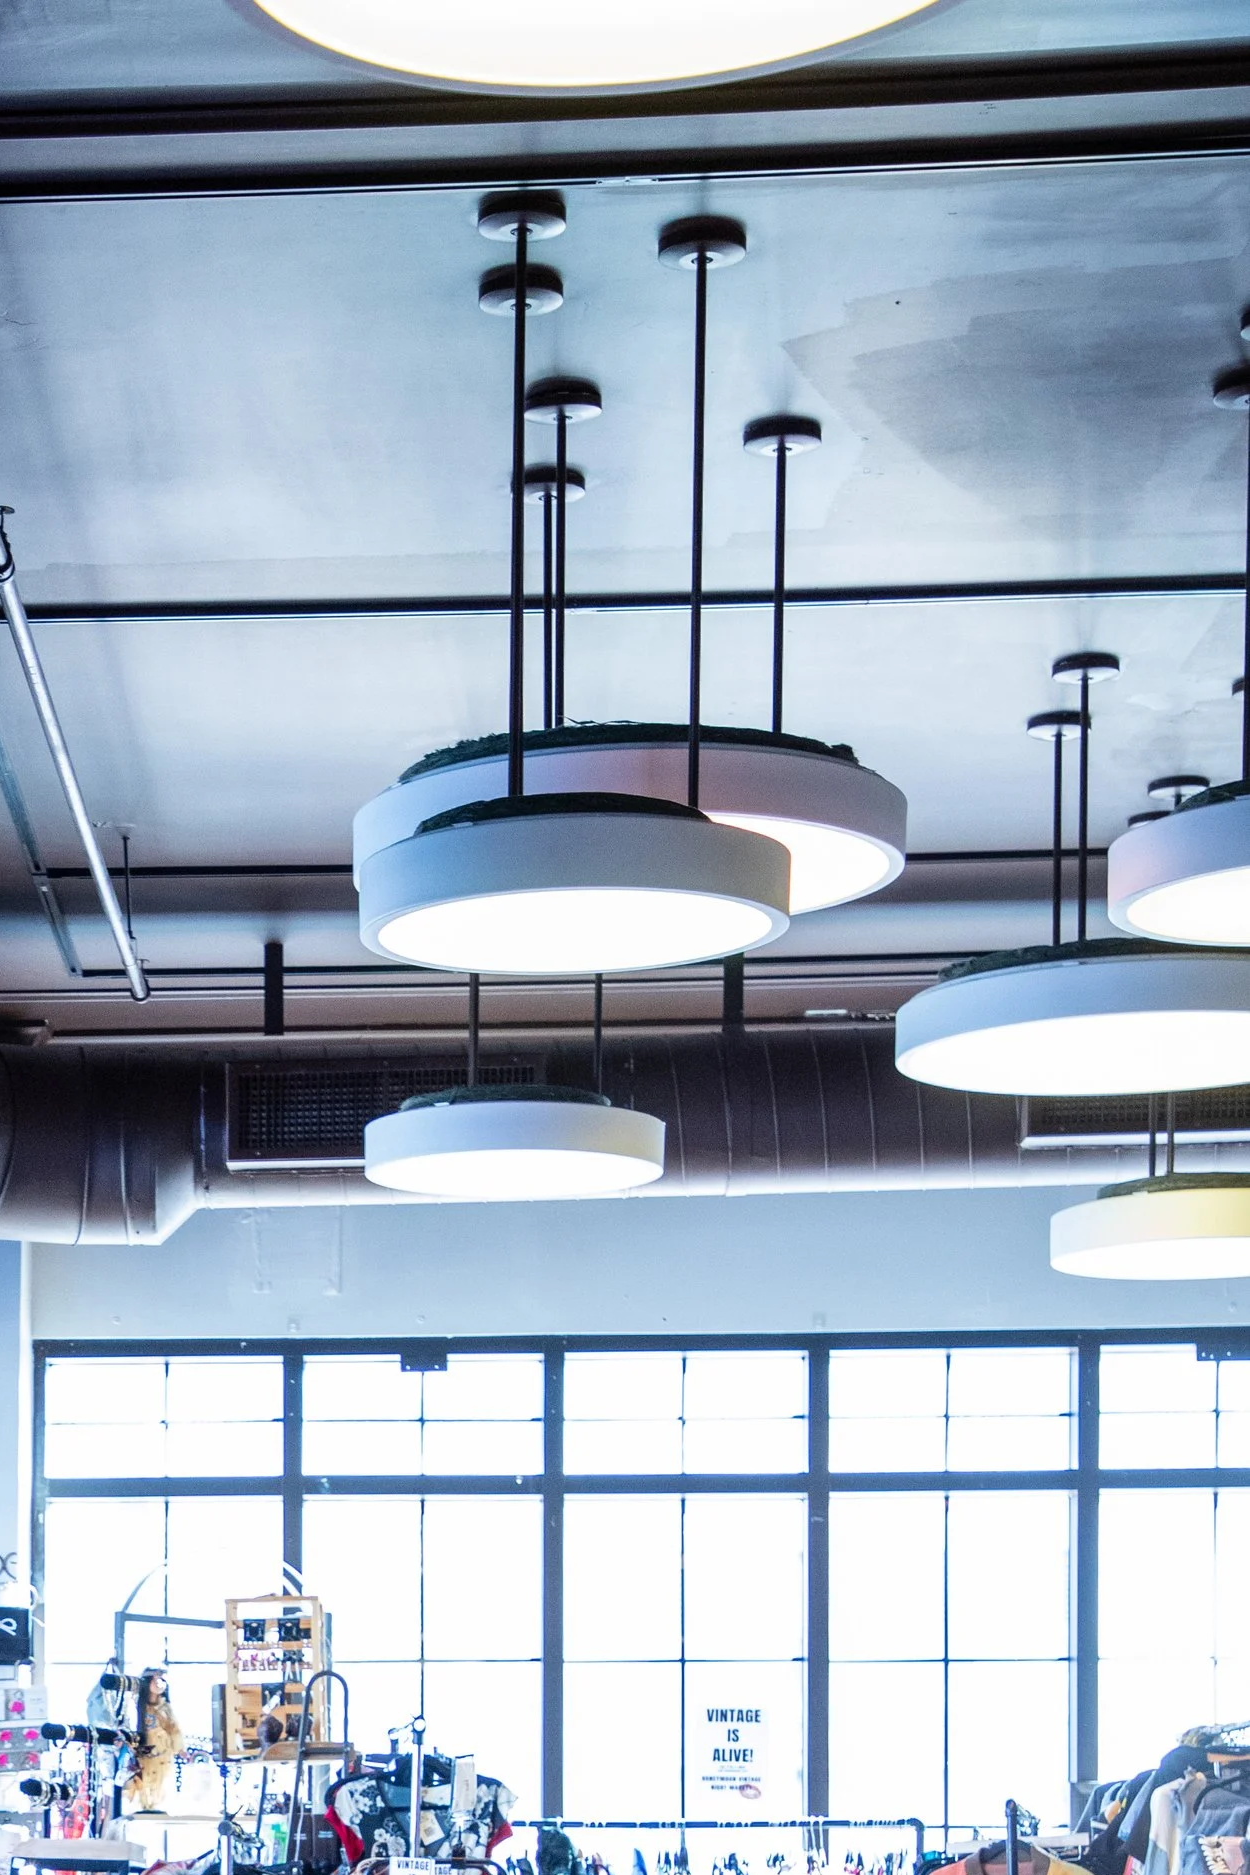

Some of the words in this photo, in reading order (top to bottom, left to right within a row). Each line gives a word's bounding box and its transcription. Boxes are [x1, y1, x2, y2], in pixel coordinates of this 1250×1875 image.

[707, 1709, 761, 1722] VINTAGE
[727, 1729, 739, 1742] IS
[713, 1749, 753, 1762] ALIVE!
[397, 1860, 429, 1870] VINTAGE
[434, 1867, 452, 1875] TAGE
